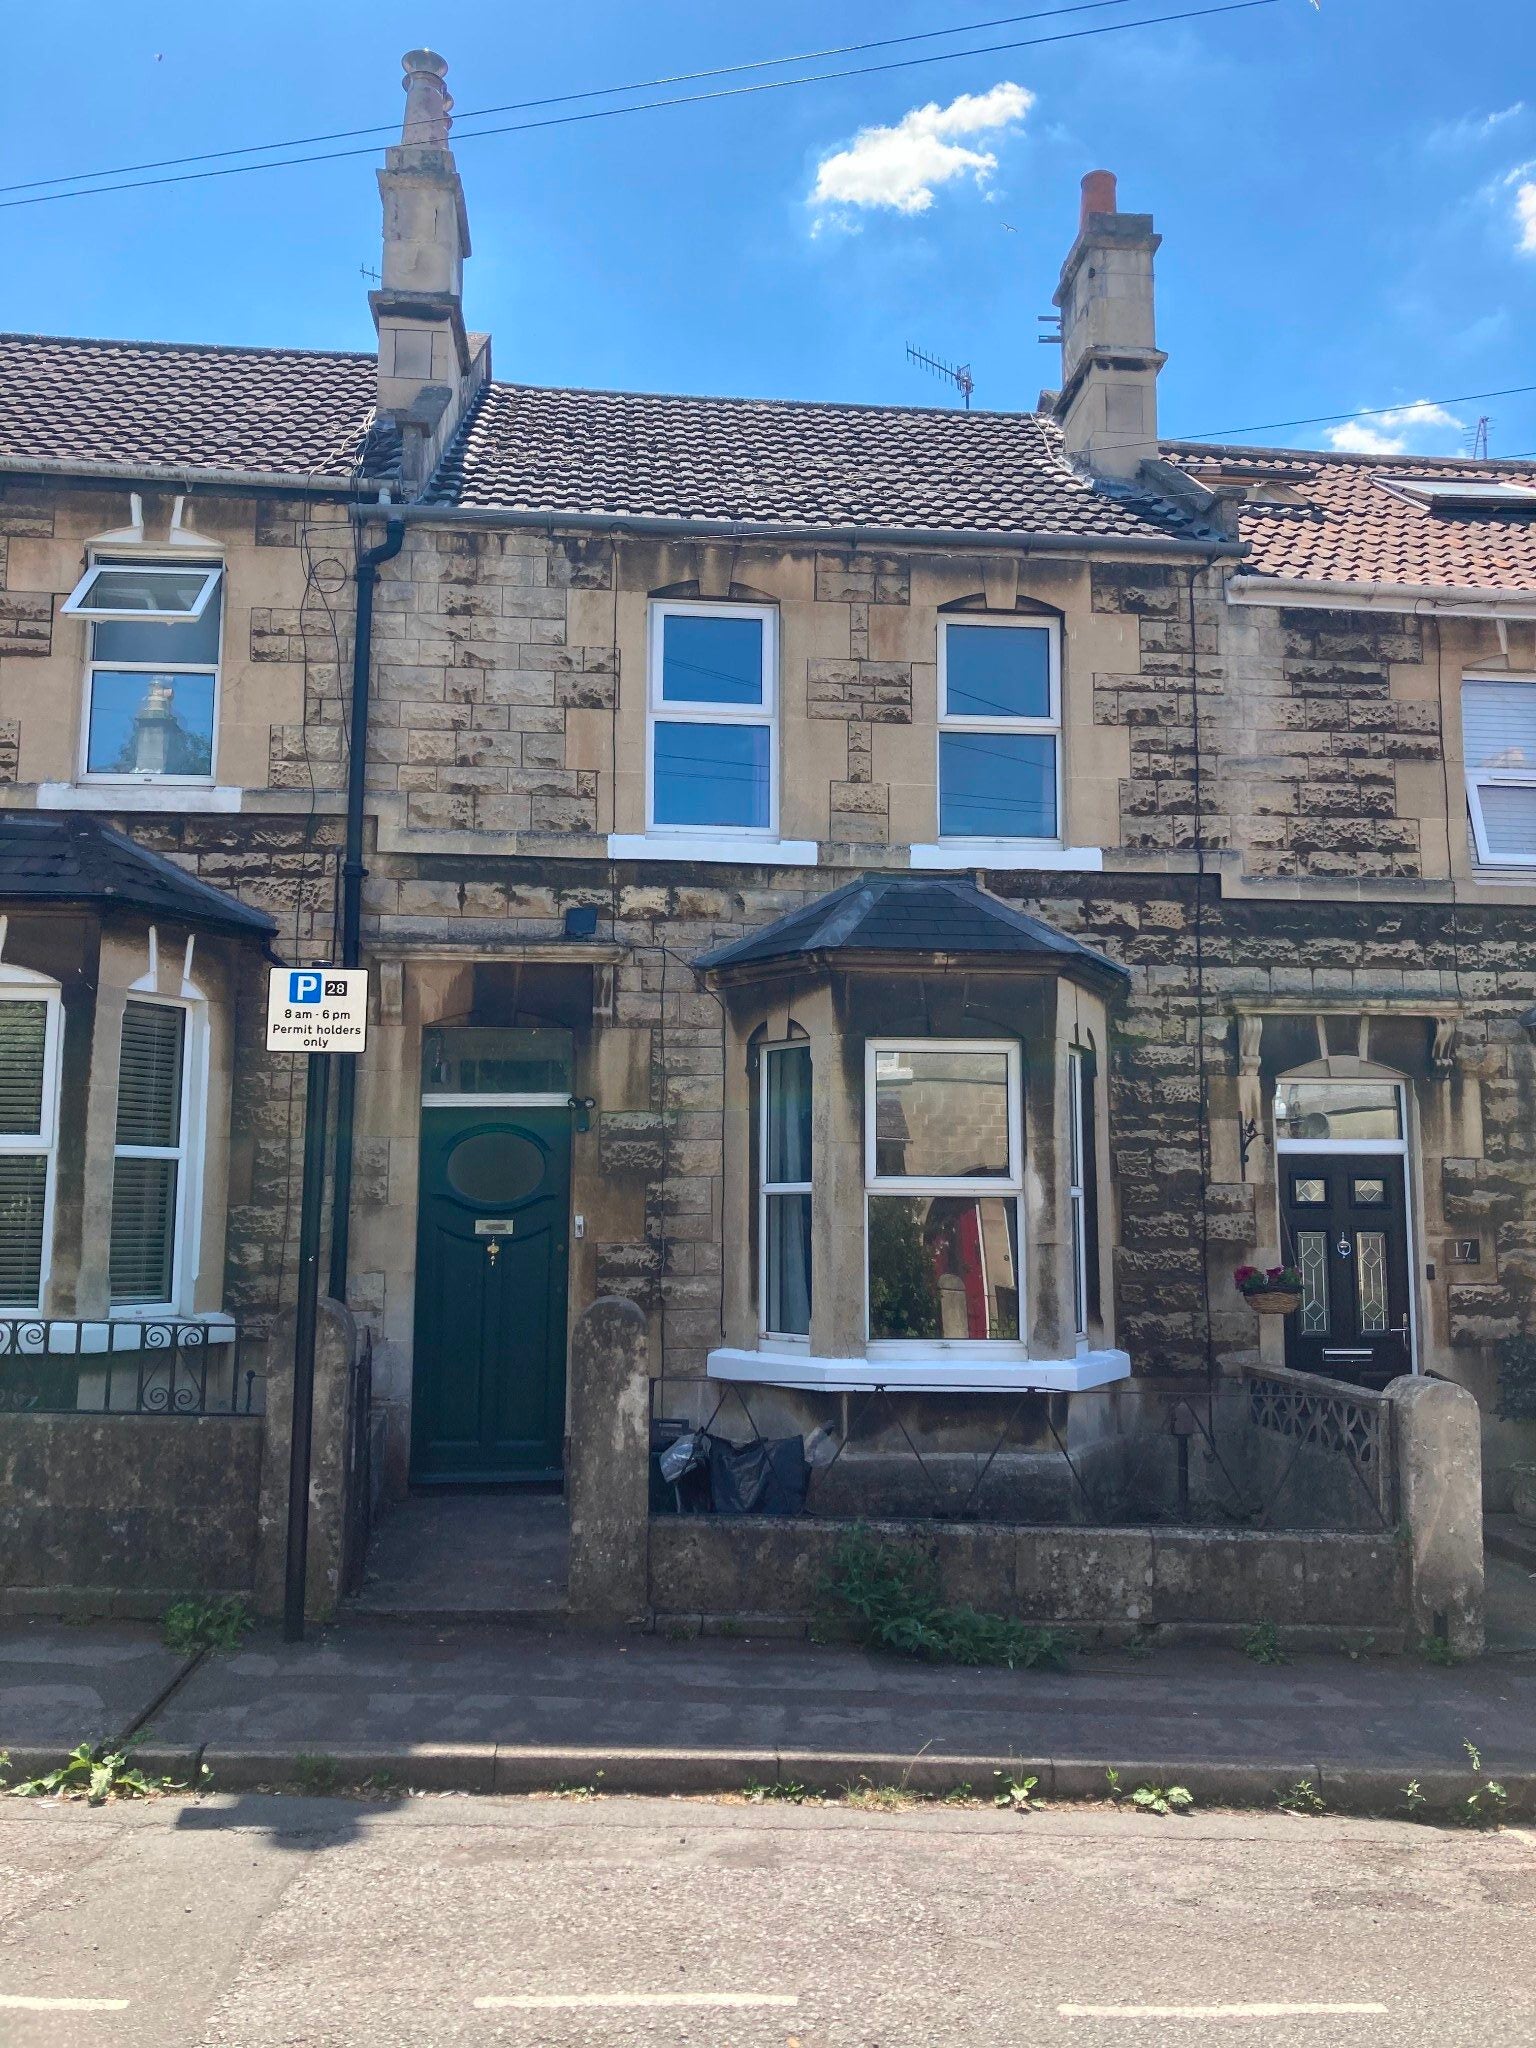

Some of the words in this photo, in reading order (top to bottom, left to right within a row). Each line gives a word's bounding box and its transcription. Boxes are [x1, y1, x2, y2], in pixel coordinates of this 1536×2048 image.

[297, 976, 317, 1001] P
[327, 983, 345, 994] 28
[284, 1009, 292, 1018] 8
[295, 1011, 312, 1019] am
[322, 1010, 329, 1019] 6
[332, 1012, 350, 1021] pm
[272, 1024, 312, 1034] Permit
[316, 1025, 361, 1035] holders
[303, 1037, 329, 1048] only
[1454, 1241, 1472, 1258] 17
